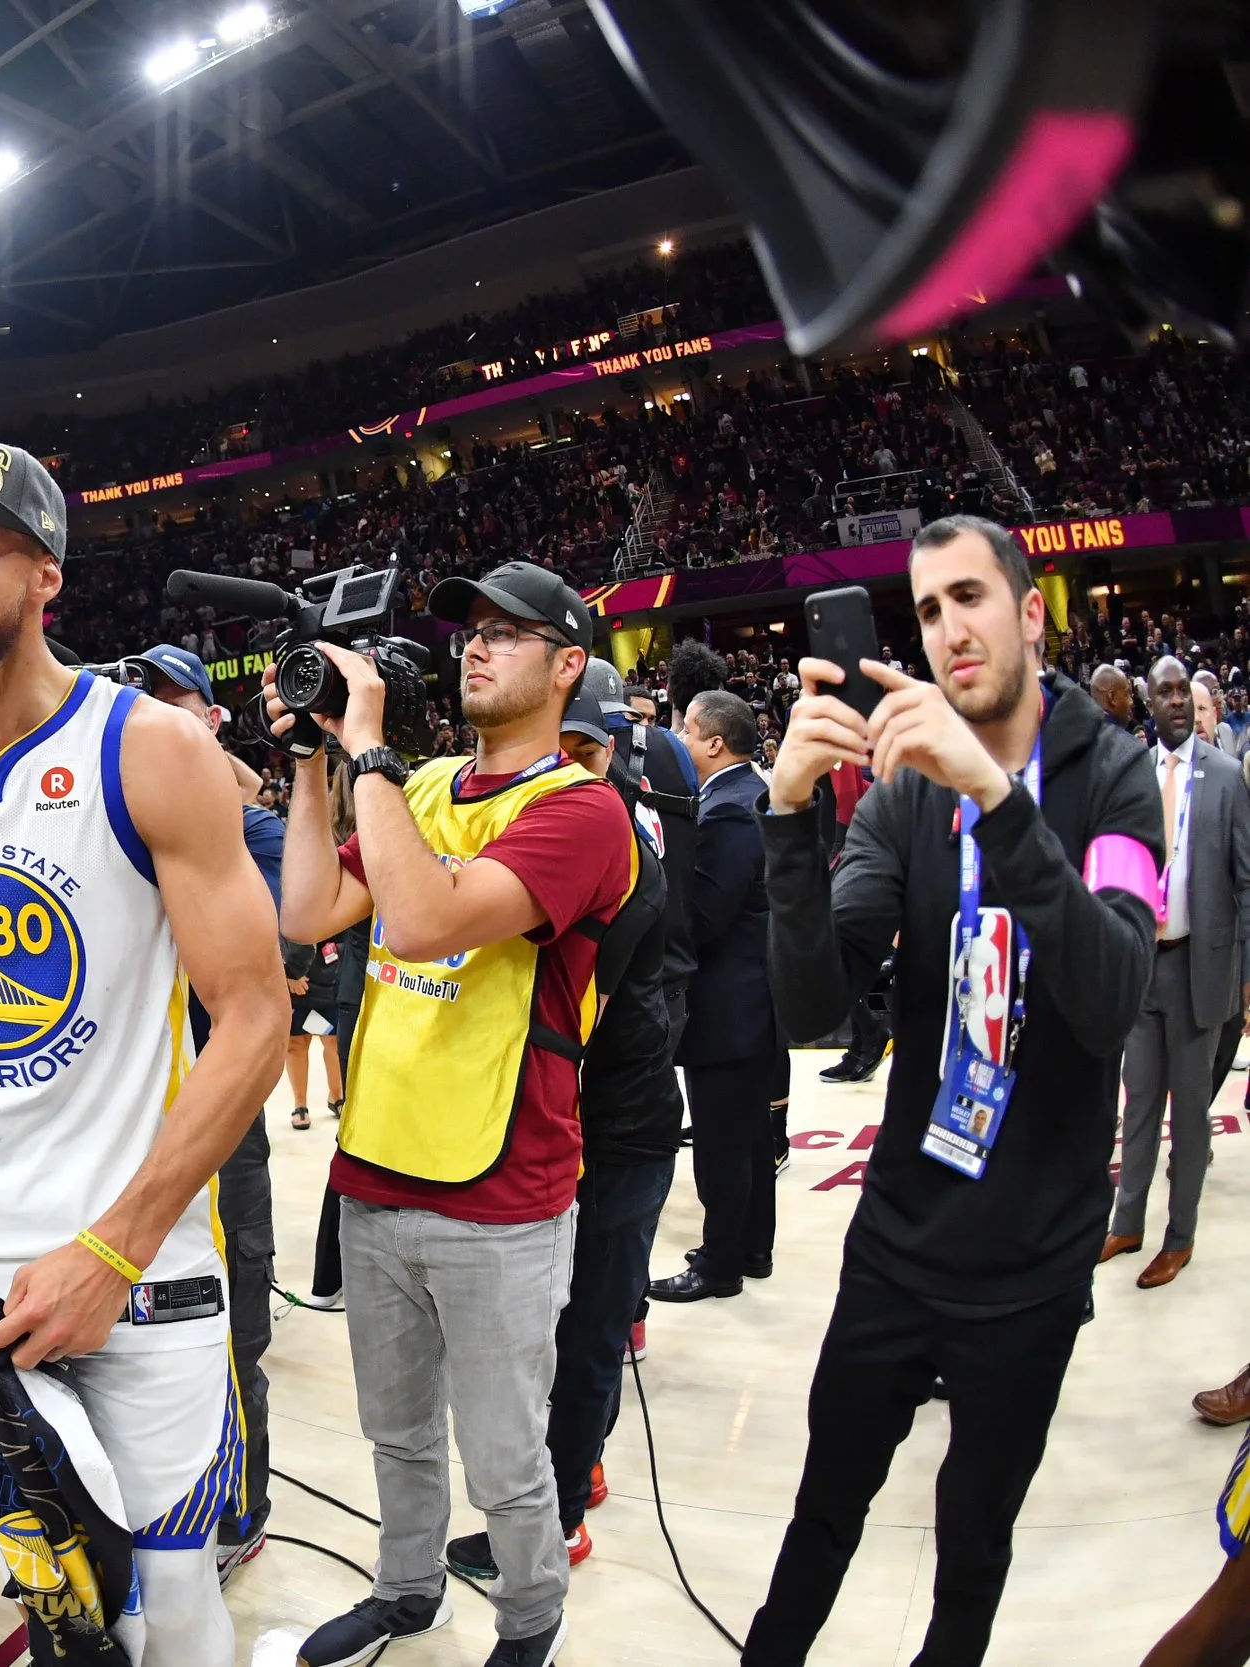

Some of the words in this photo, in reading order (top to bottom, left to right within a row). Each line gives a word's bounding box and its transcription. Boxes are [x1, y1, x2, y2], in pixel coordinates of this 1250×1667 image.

[593, 354, 641, 376] THANK
[642, 345, 672, 364] YOU
[674, 337, 712, 357] FANS
[81, 486, 123, 504] THANK
[125, 480, 150, 496] YOU
[152, 472, 183, 490] FANS
[1021, 526, 1067, 554] YOU
[1072, 519, 1124, 549] FANS
[205, 658, 239, 682] YOU
[243, 650, 276, 676] FAN
[50, 776, 65, 793] R
[35, 798, 80, 812] Rakuten
[2, 845, 82, 899] STATE
[87, 1237, 116, 1261] JESUS
